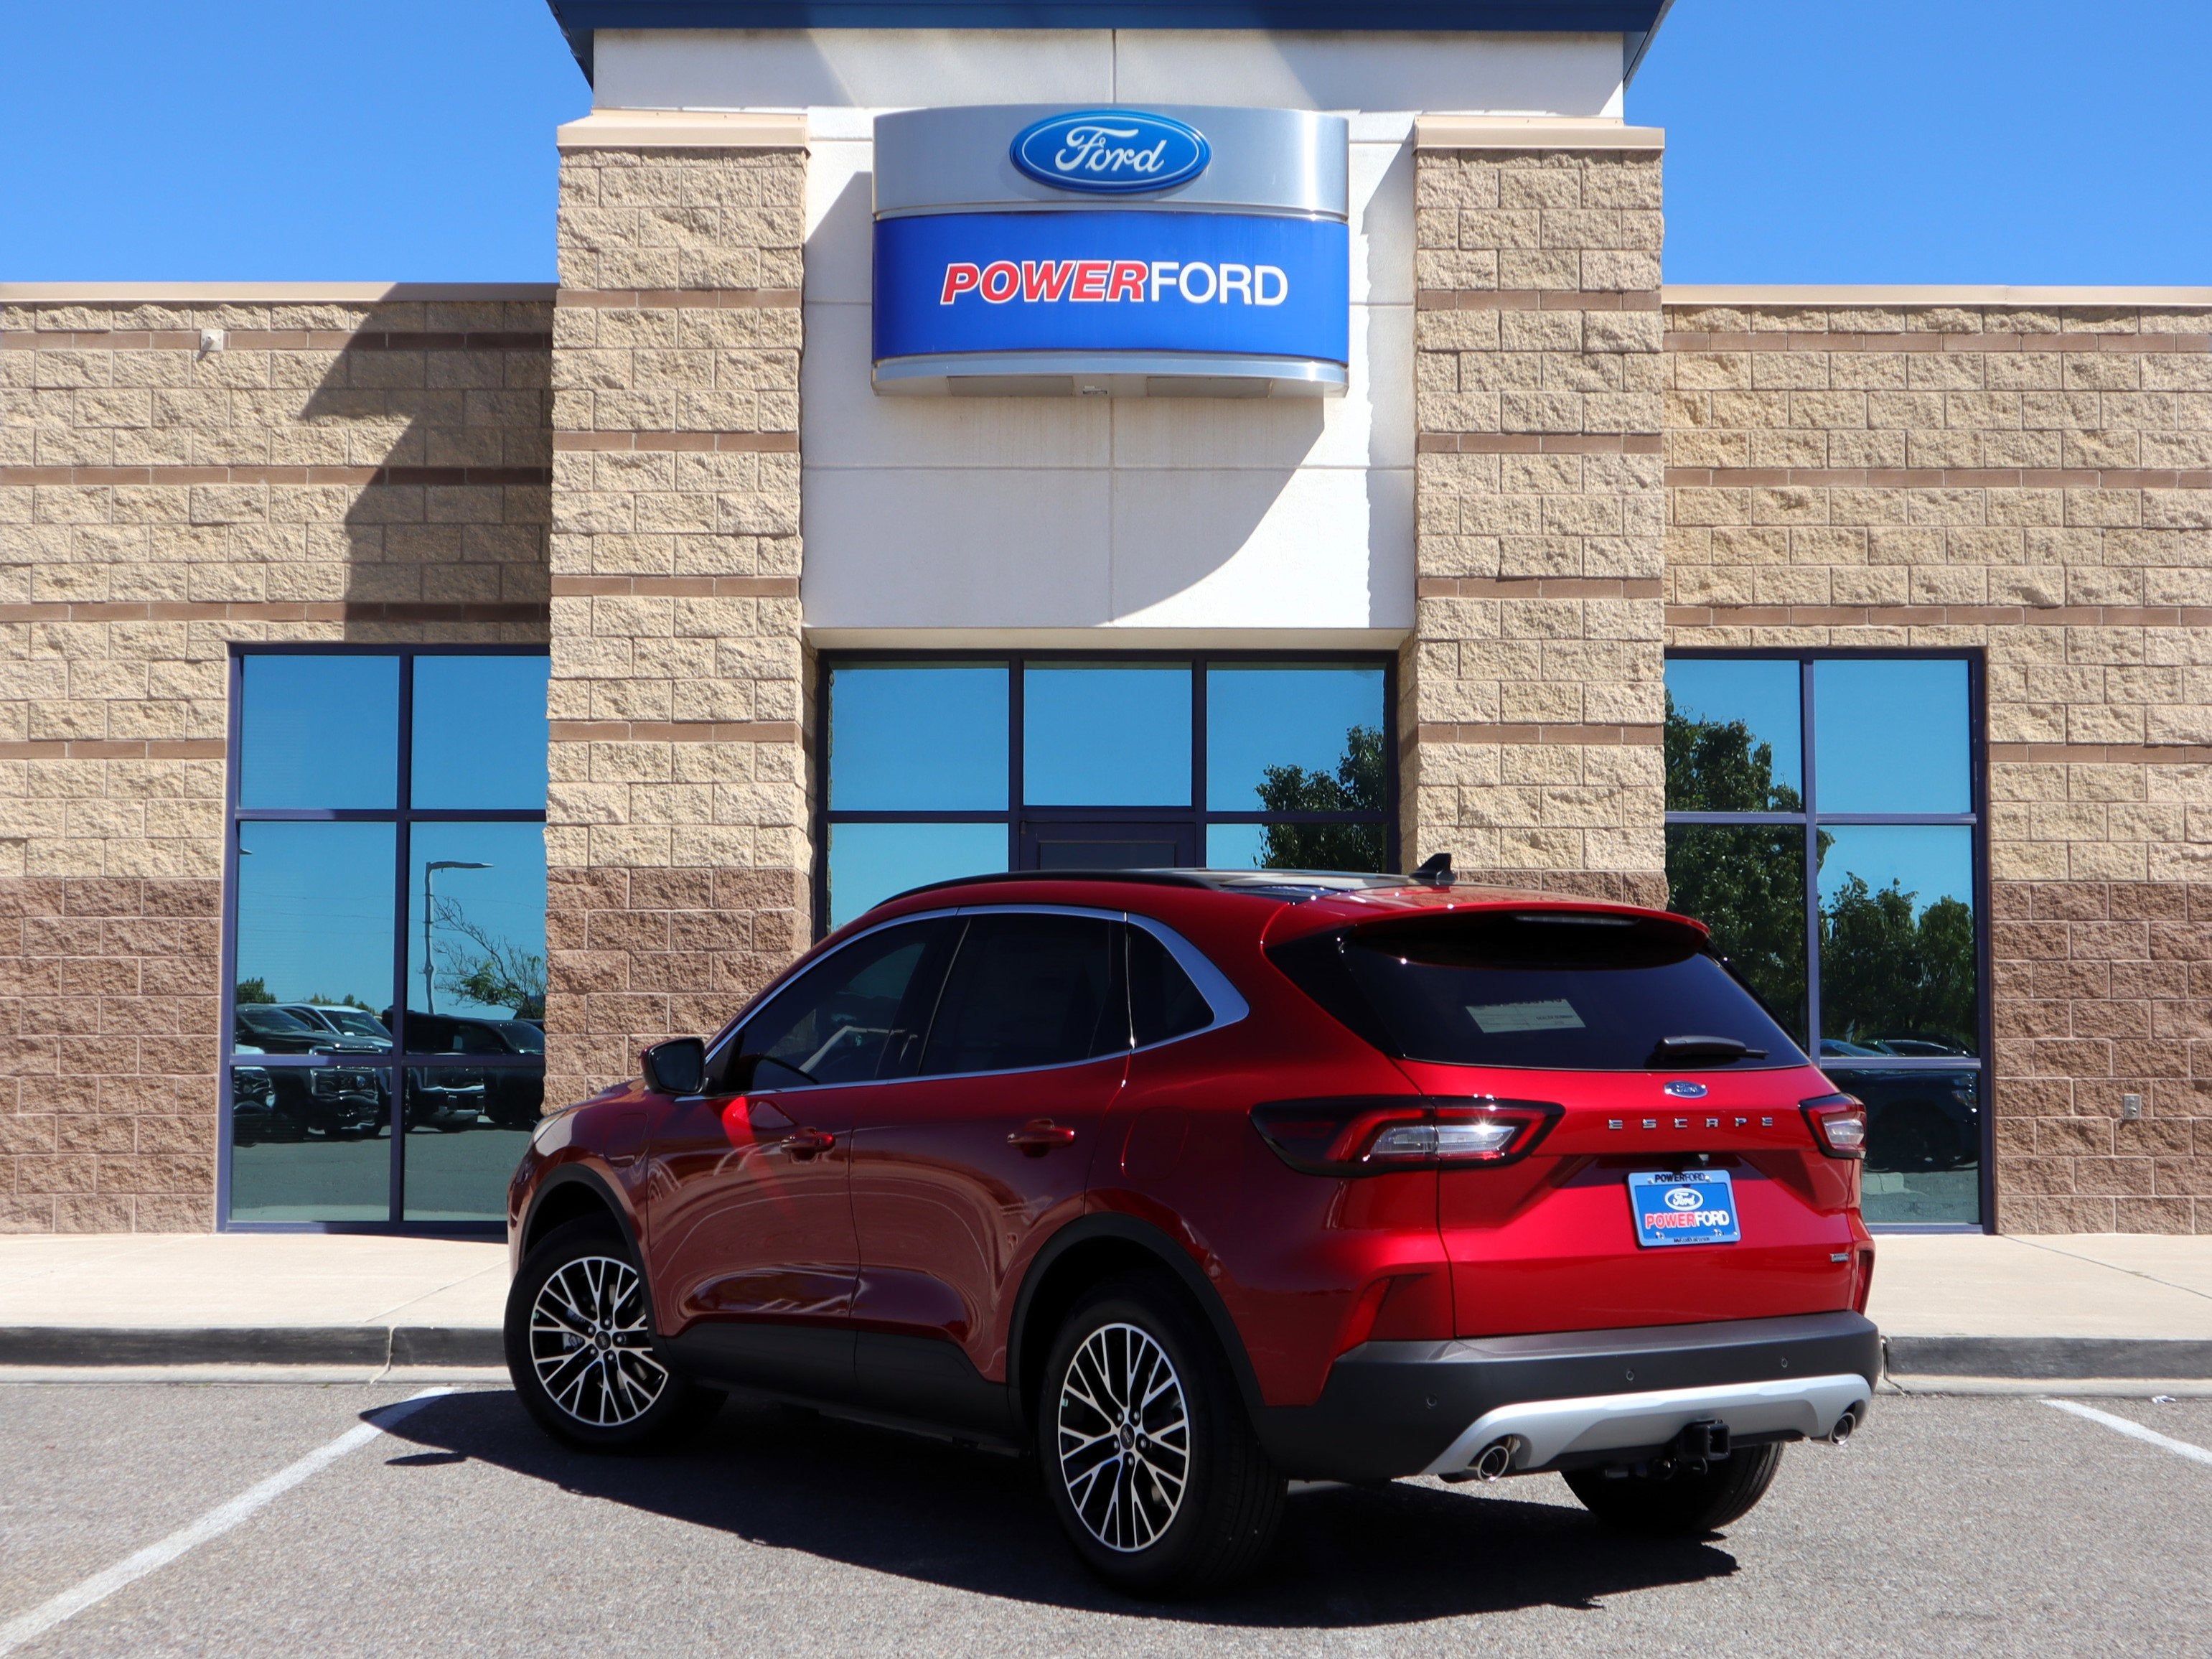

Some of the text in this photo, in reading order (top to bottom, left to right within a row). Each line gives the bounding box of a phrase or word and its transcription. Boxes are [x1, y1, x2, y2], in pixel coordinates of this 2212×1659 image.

[1054, 125, 1167, 173] Ford
[940, 260, 1288, 307] POWERFORD
[1608, 1117, 1773, 1130] ESCAPE
[1672, 1192, 1696, 1206] Ford
[1645, 1210, 1730, 1230] POWERFORD
